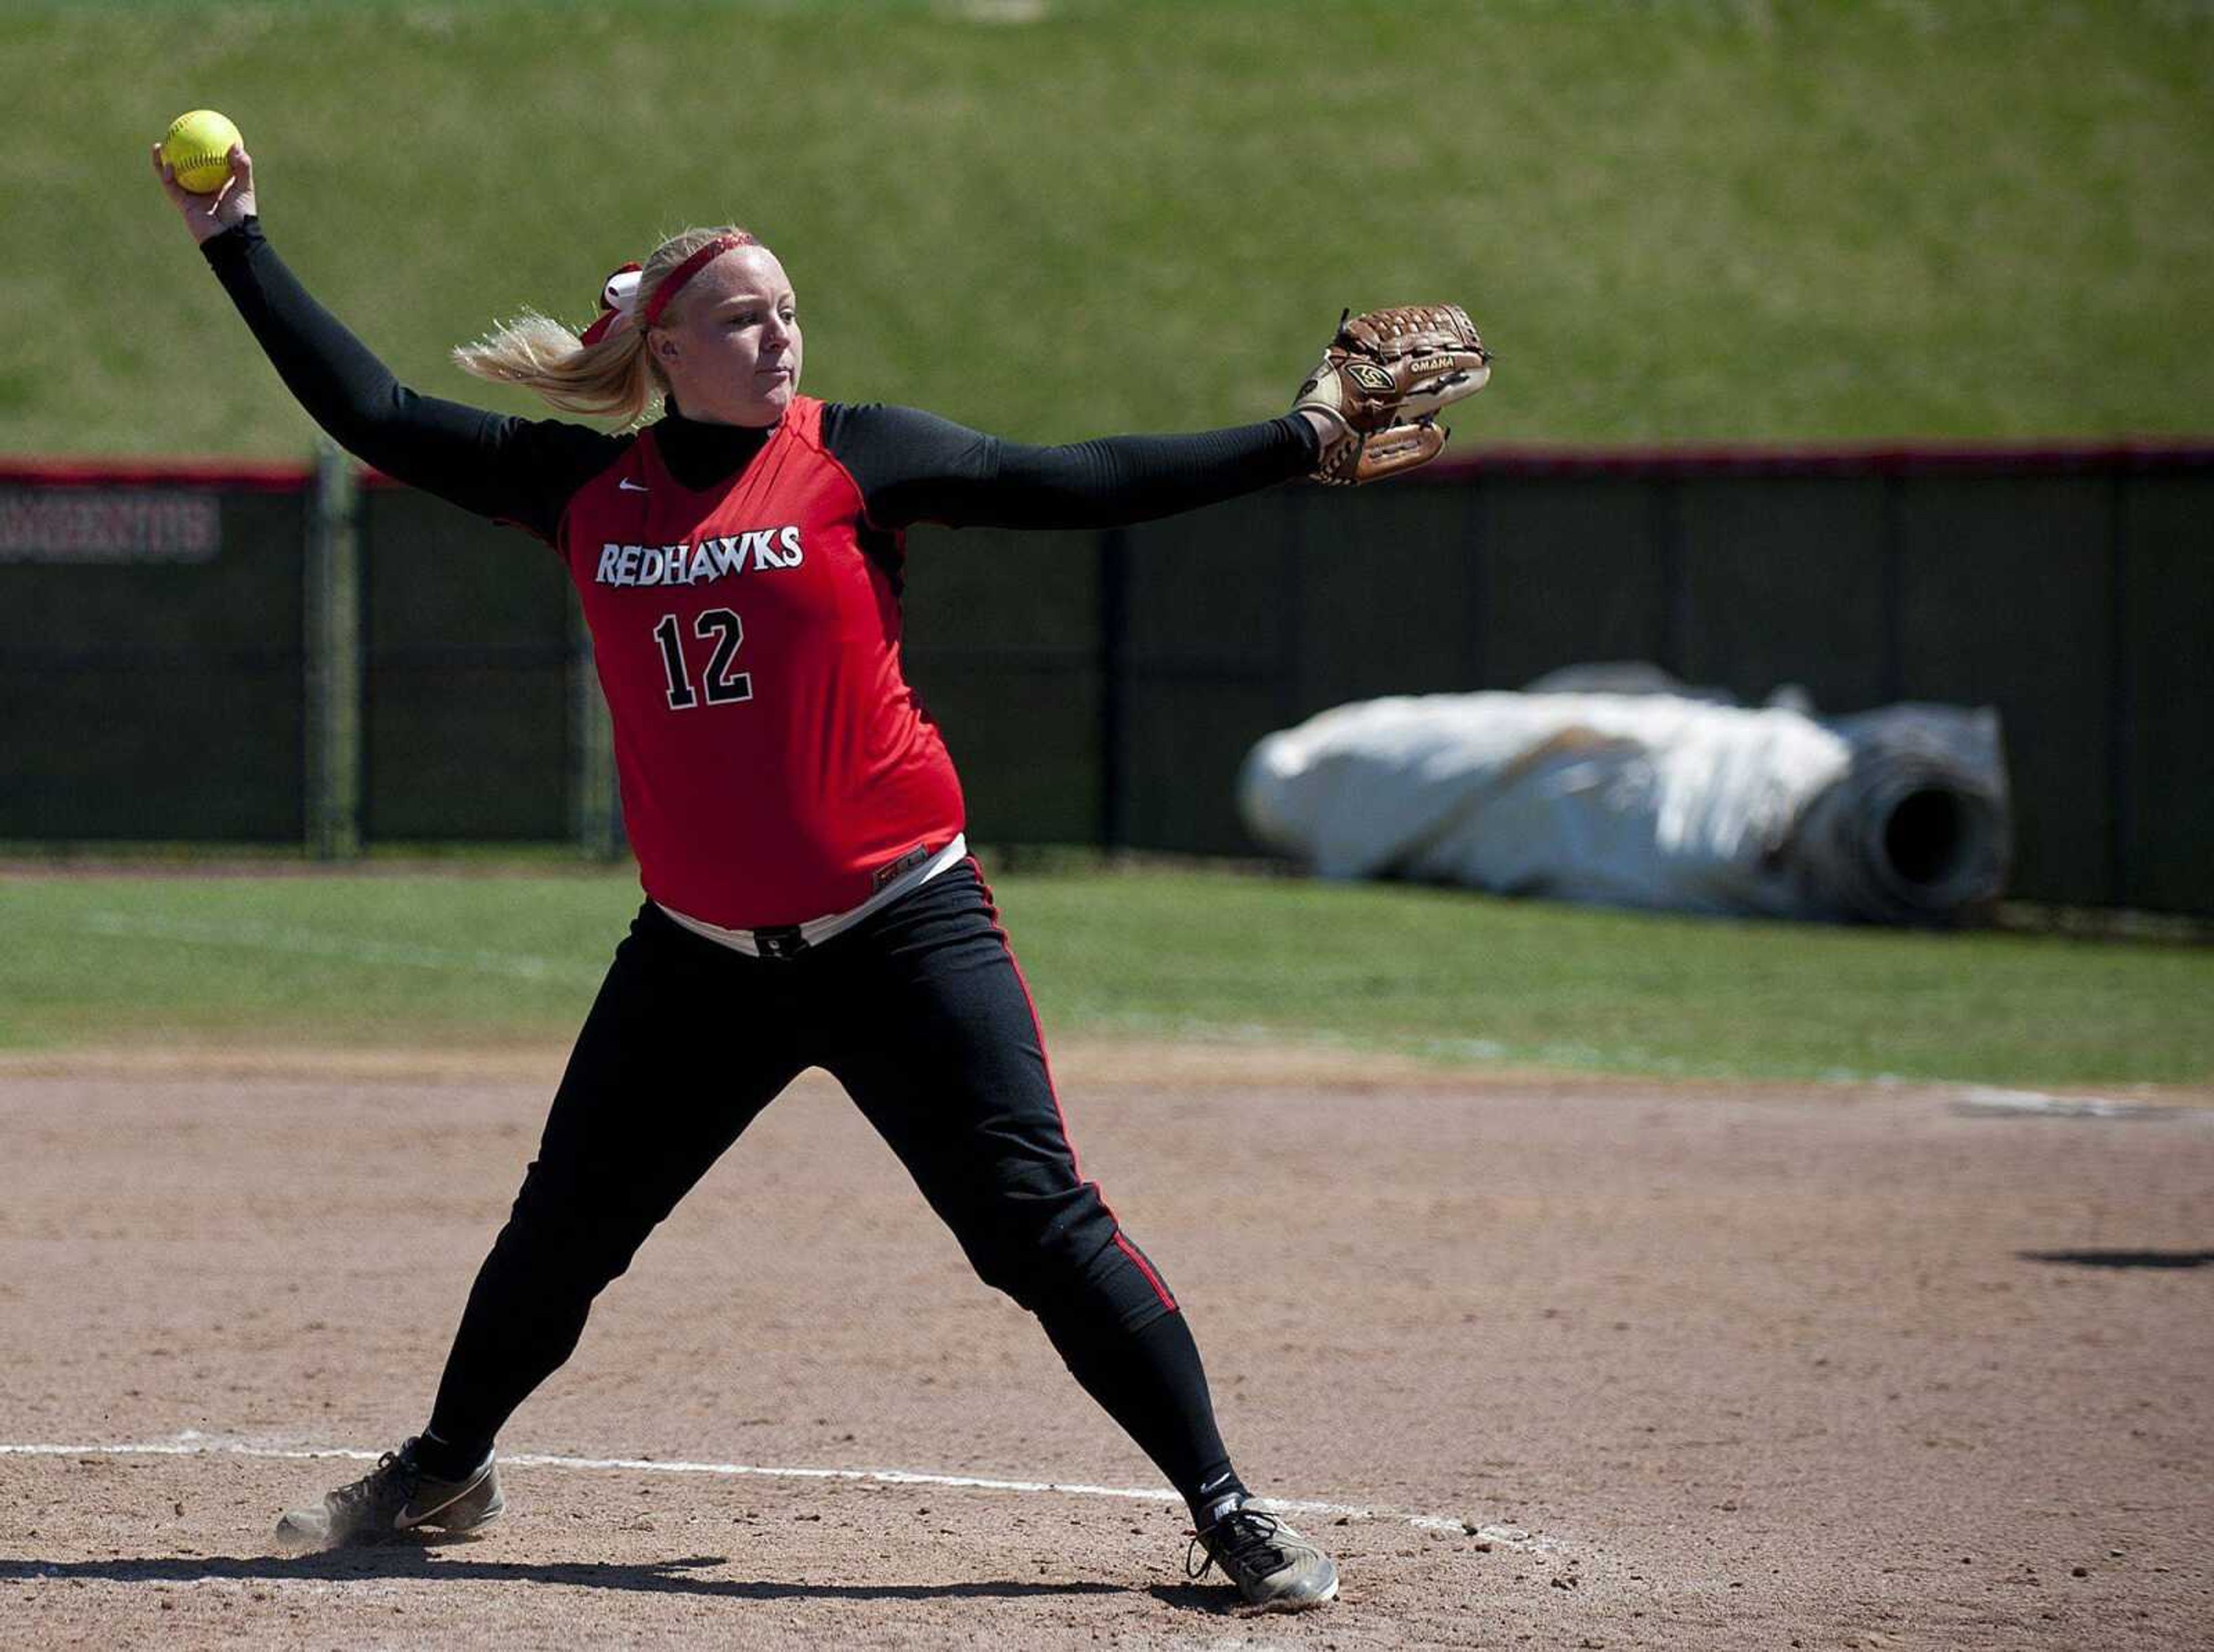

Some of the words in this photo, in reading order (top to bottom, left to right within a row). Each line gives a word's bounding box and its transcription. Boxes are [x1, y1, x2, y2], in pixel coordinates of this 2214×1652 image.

[1411, 356, 1454, 372] OMAHA
[595, 525, 804, 587] REDHAWKS
[653, 607, 753, 710] 12
